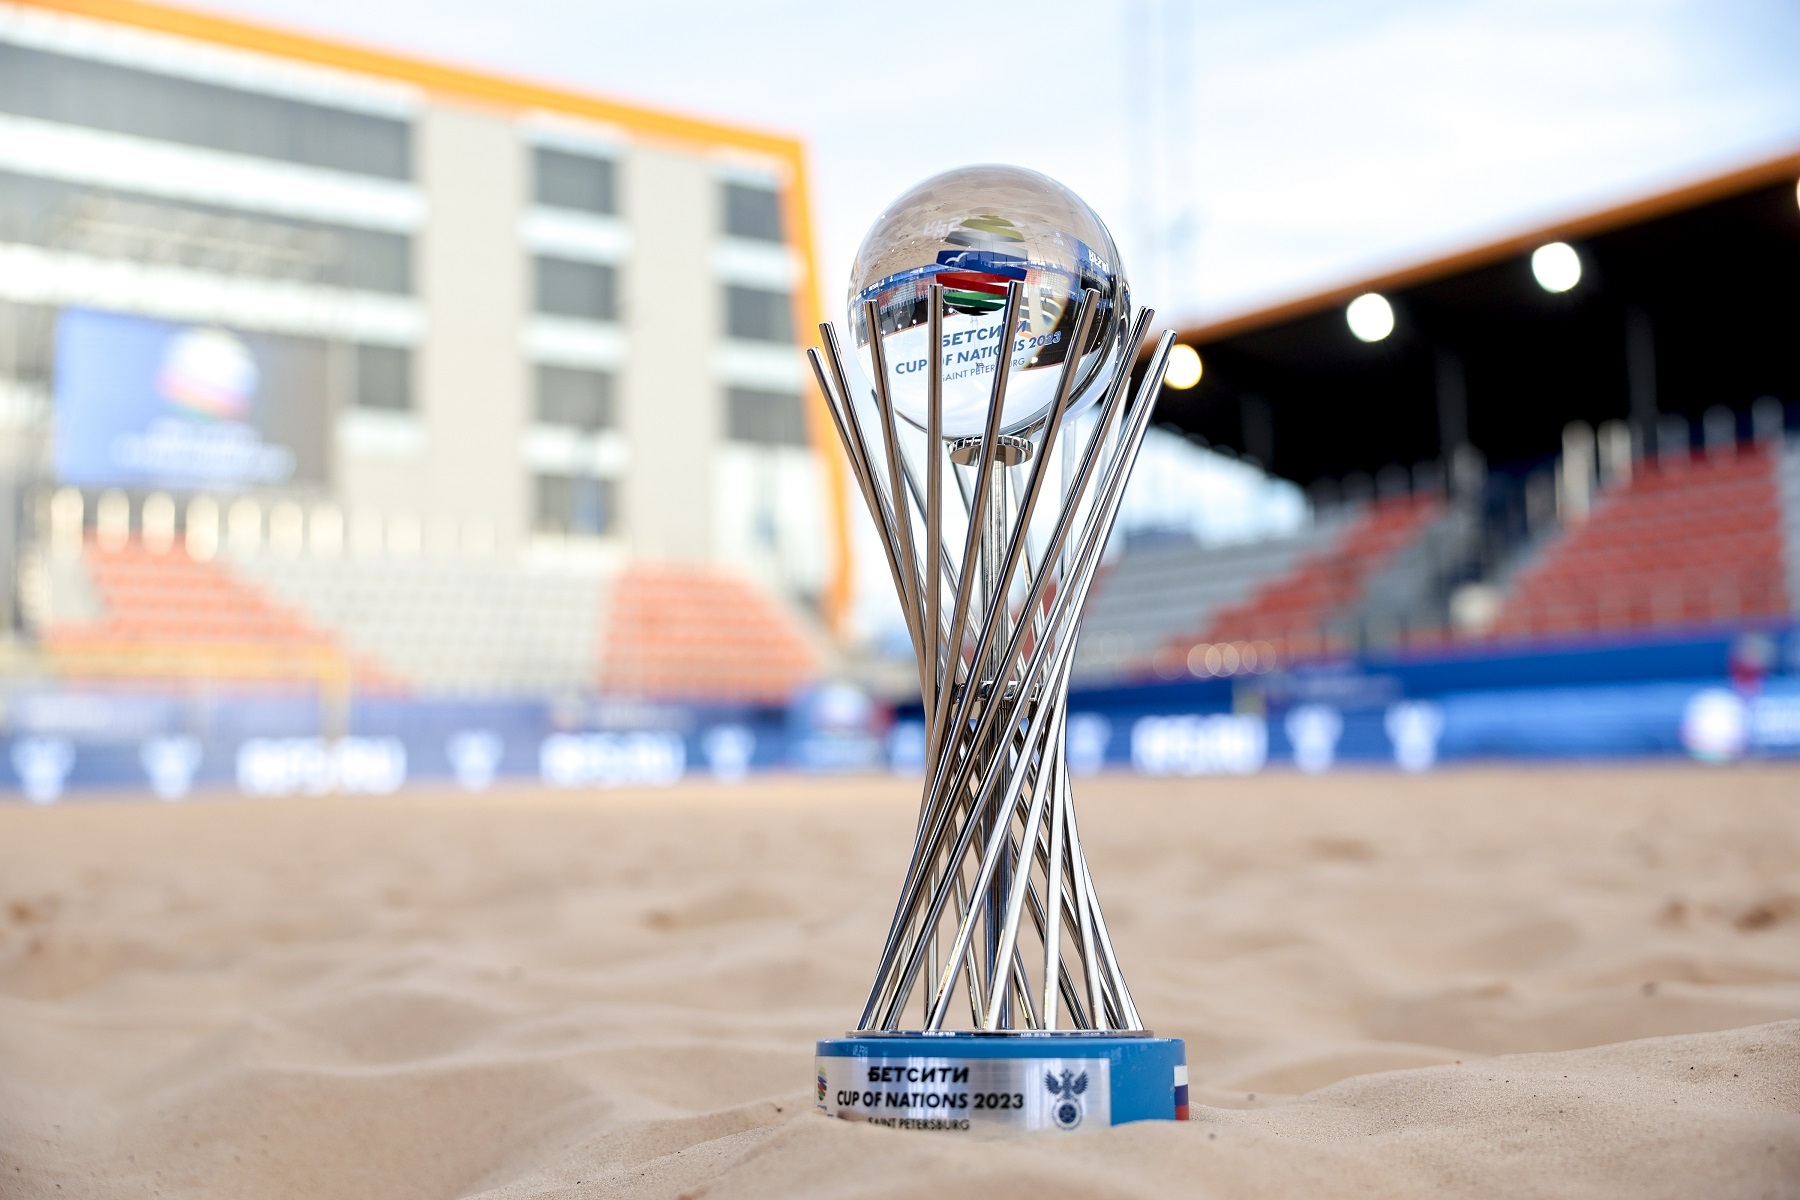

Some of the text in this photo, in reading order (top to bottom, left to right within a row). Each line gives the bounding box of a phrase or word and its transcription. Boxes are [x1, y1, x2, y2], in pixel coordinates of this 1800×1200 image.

[943, 320, 1028, 347] БЕТСИИ
[895, 359, 928, 375] CUP
[1028, 331, 1062, 349] 2023
[867, 1066, 970, 1083] БЕТСИТИ
[837, 1090, 1024, 1110] CUP OF NATIONS 2023
[898, 1117, 970, 1131] PETERSBURG
